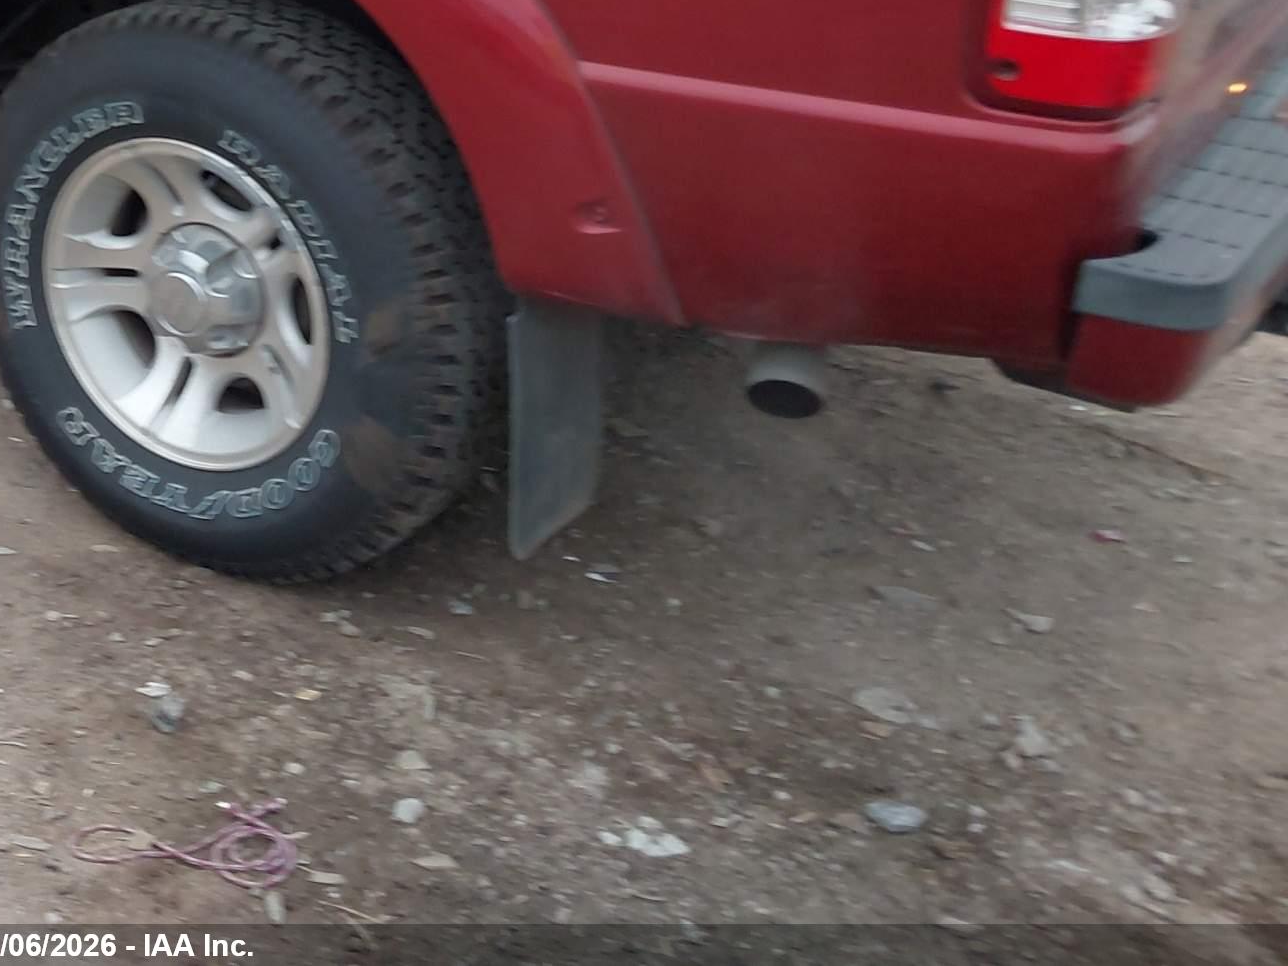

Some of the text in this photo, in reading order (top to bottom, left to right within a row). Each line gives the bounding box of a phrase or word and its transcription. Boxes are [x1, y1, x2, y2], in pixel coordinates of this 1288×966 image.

[1, 101, 145, 330] WRANGLER
[217, 129, 360, 344] RADIAL
[56, 406, 342, 520] GOODYEAR
